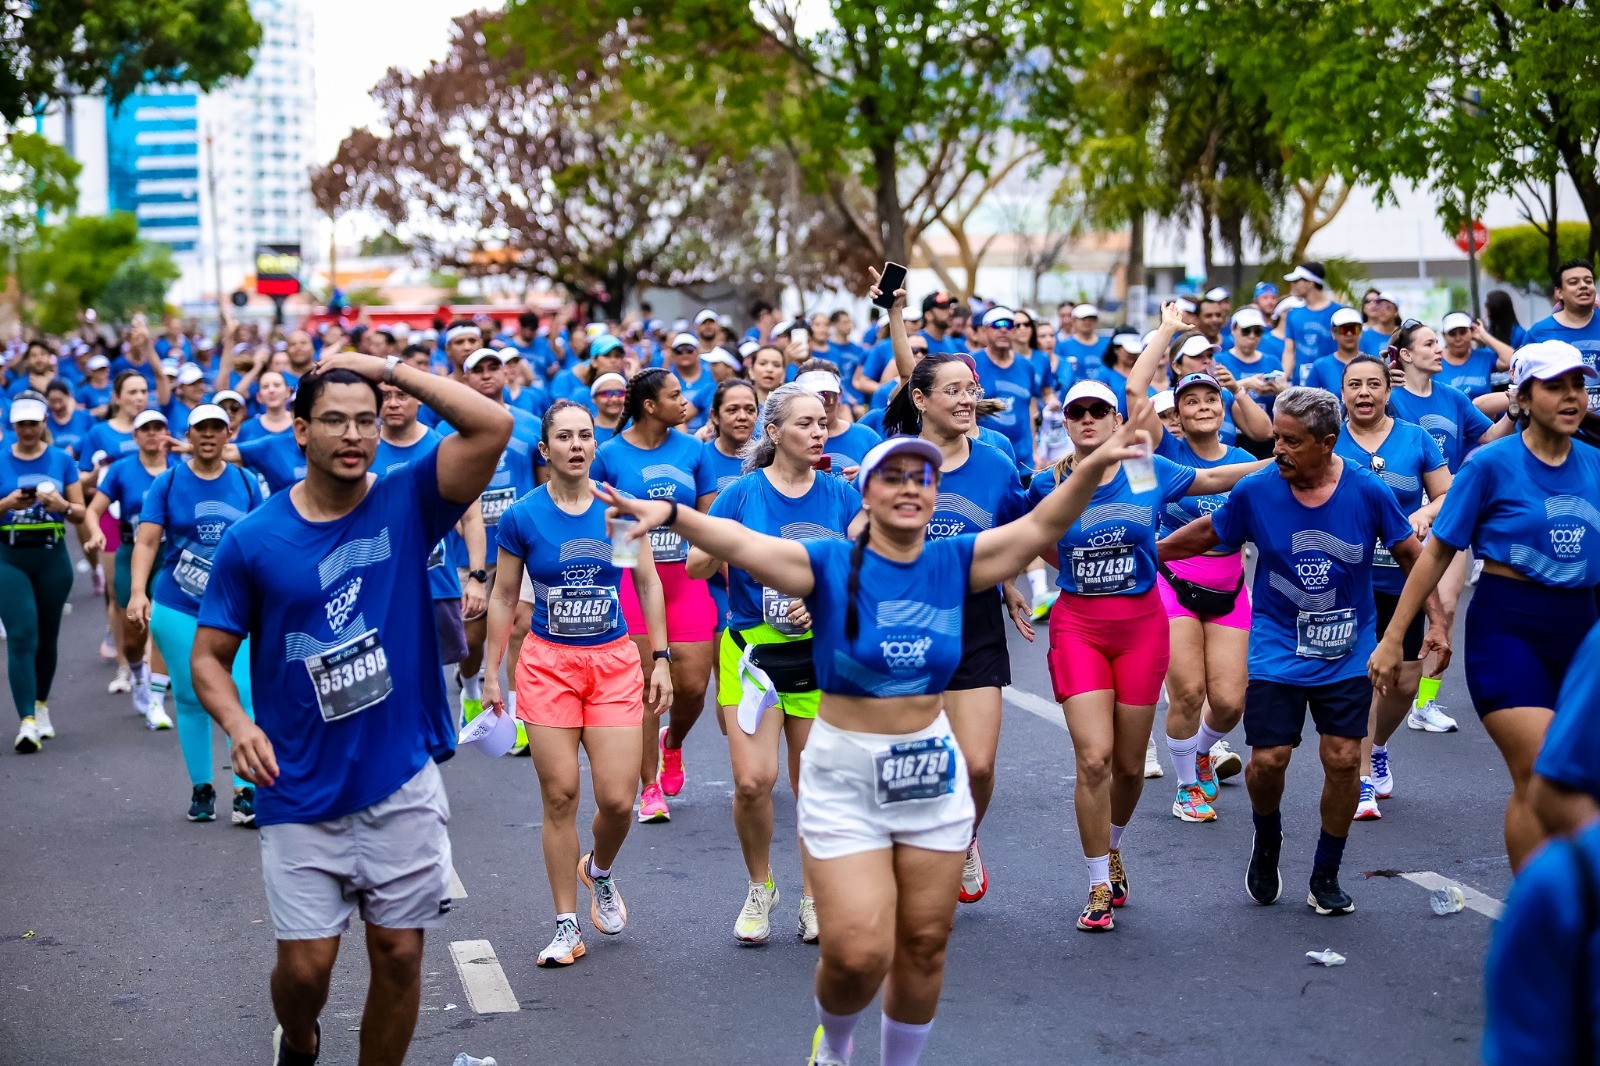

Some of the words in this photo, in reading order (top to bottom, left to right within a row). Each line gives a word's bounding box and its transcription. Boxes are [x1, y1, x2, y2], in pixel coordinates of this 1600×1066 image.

[926, 521, 966, 537] 100%
[1087, 526, 1127, 548] 100%
[1548, 526, 1587, 544] 100%
[561, 565, 602, 581] 100%
[1076, 557, 1135, 577] 63743D
[1295, 560, 1332, 577] 100%
[553, 599, 612, 617] 63845D
[1306, 622, 1354, 641] 61811D
[880, 636, 933, 658] 100%
[319, 646, 388, 696] 55369D
